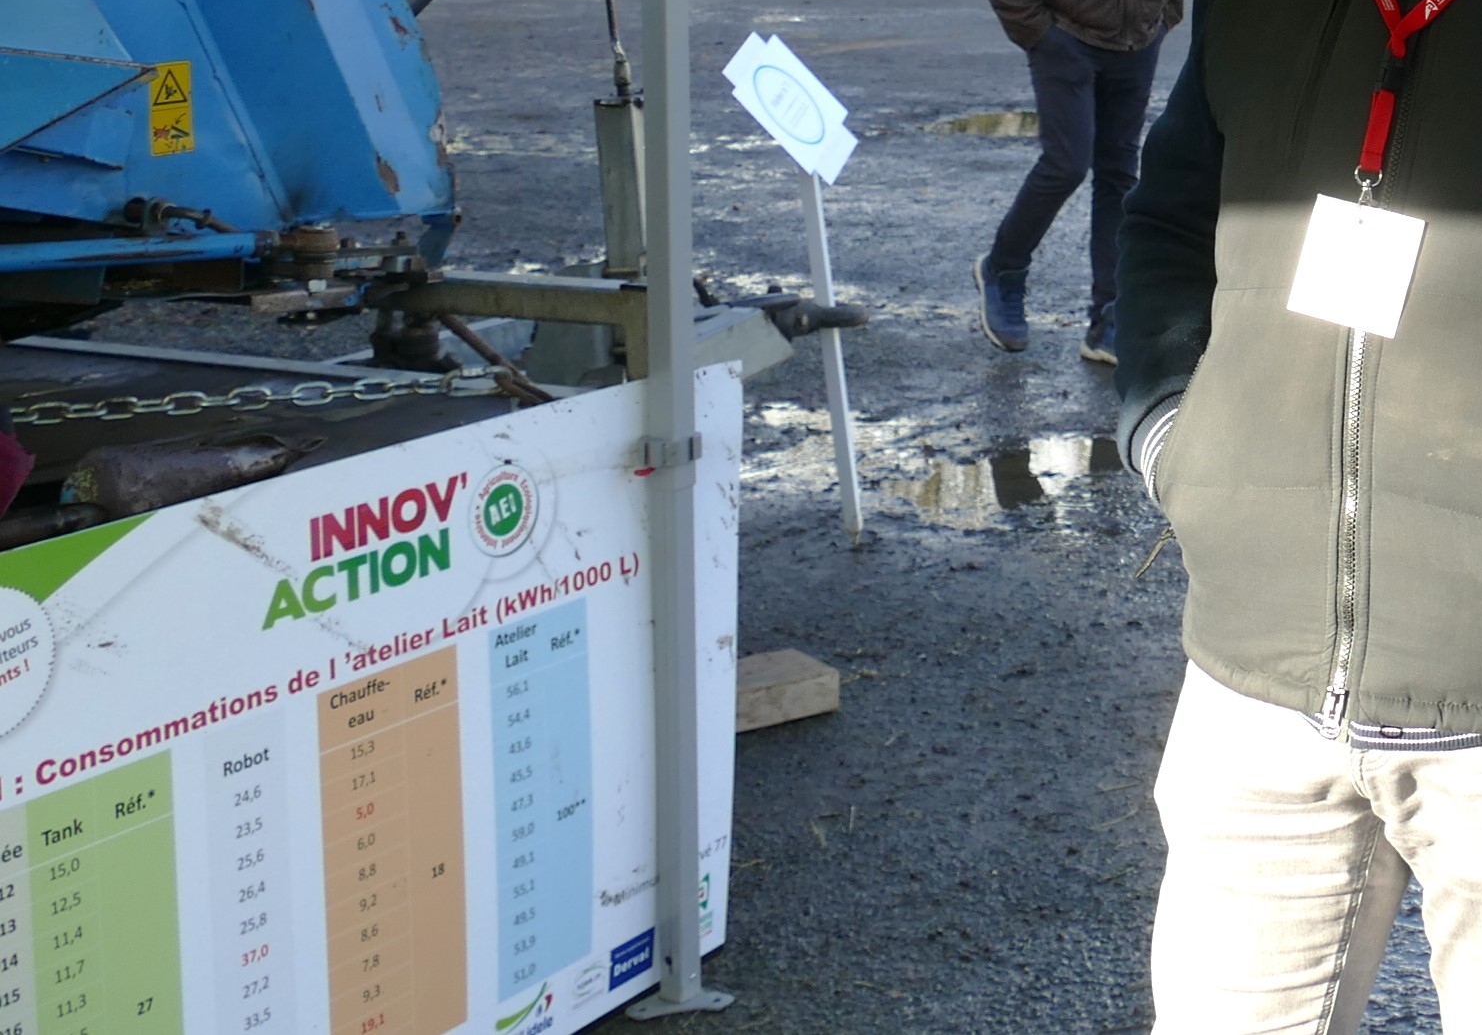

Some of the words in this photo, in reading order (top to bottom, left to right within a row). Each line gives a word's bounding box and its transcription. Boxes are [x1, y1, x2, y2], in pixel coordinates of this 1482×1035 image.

[310, 471, 468, 562] INNOV'
[488, 492, 517, 527] AEI
[261, 528, 451, 631] ACTION
[494, 623, 538, 649] Atelier
[35, 687, 279, 785] Consommations
[288, 668, 320, 695] de
[442, 605, 488, 638] Lait
[619, 552, 640, 577] L)
[505, 650, 529, 669] Lait
[330, 679, 391, 710] Chauffe-
[348, 710, 375, 729] eau
[351, 740, 376, 760] 15,3
[223, 748, 270, 777] Robot
[352, 770, 376, 791] 17,1
[234, 785, 263, 807] 24,6
[356, 802, 375, 820] 5,0
[41, 819, 84, 846] Tank
[235, 817, 263, 840] 23,5
[357, 833, 376, 852] 6,0
[50, 858, 80, 881] 15,0
[237, 849, 264, 872] 25,6
[431, 863, 446, 880] 18
[358, 863, 377, 882] 8,8
[238, 880, 265, 903] 26,4
[359, 893, 378, 913] 9,2
[51, 891, 82, 916] 12,5
[240, 913, 267, 936] 25,8
[53, 926, 83, 950] 11,4
[241, 944, 269, 968] 37,0
[362, 954, 381, 973] 7,8
[55, 959, 85, 984] 11,7
[243, 976, 270, 1000] 27,2
[362, 985, 382, 1005] 9,3
[57, 993, 87, 1018] 11,3
[136, 997, 154, 1018] 27
[243, 1008, 271, 1031] 33,5
[360, 1012, 385, 1035] 19,1
